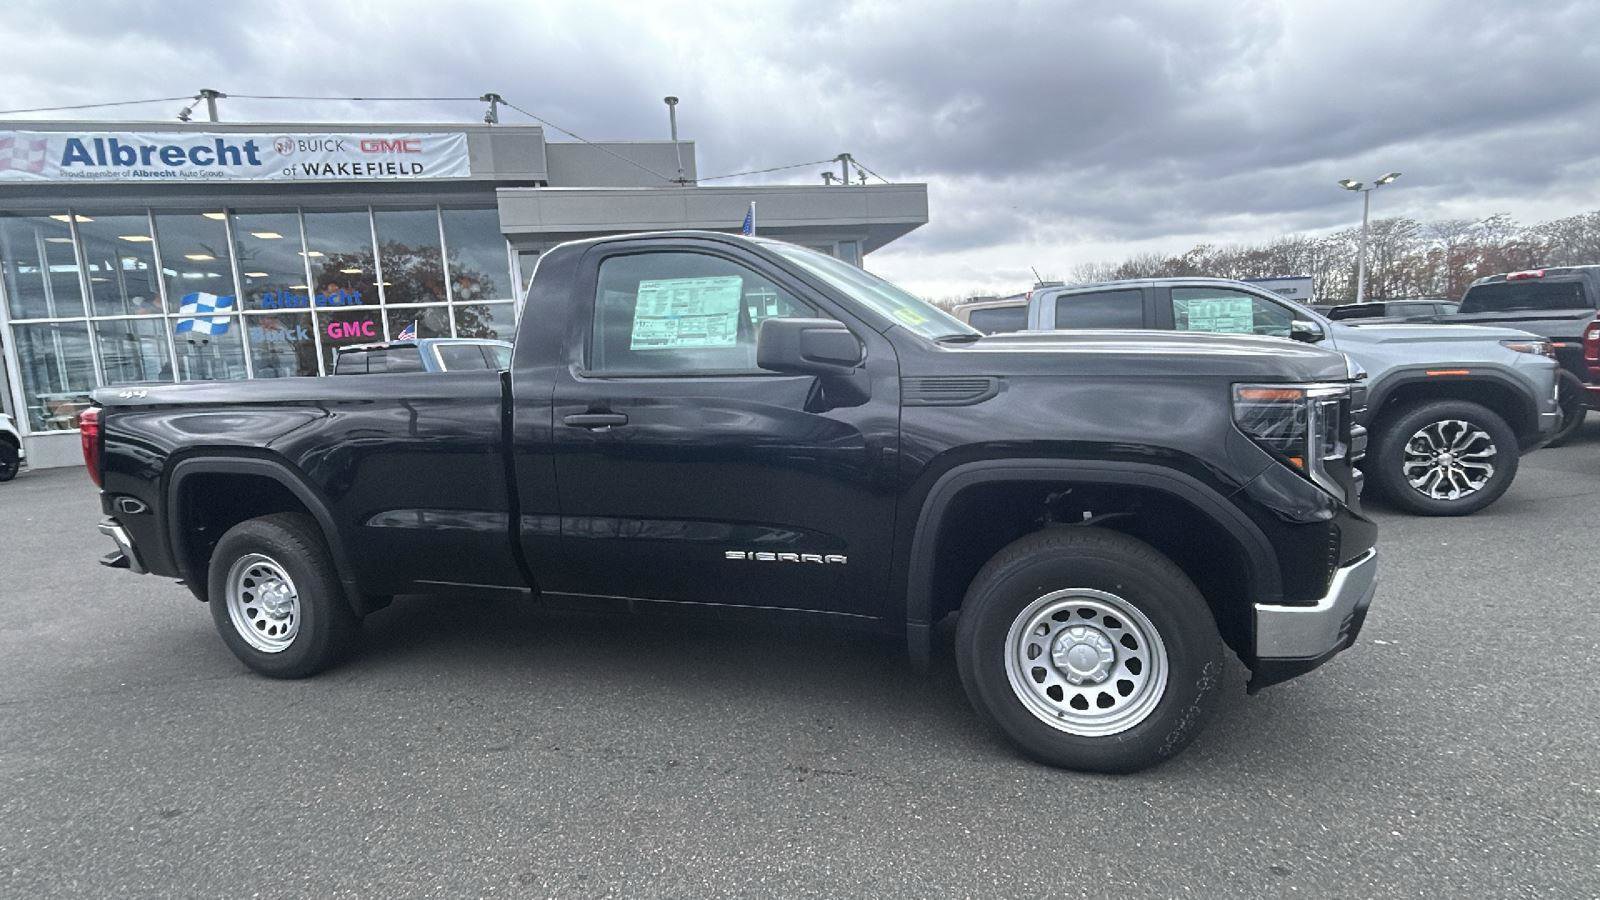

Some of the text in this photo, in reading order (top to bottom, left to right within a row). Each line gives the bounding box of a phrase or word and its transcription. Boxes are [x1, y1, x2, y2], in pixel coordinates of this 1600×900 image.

[61, 138, 262, 166] Albrecht
[299, 139, 422, 153] BUICK GMC
[59, 169, 224, 178] Proud member of Albrecht Auto Group
[283, 162, 424, 176] of WAKEFIELD
[261, 289, 363, 308] Albrecht
[327, 320, 377, 339] GMC
[724, 550, 848, 564] SIERRA
